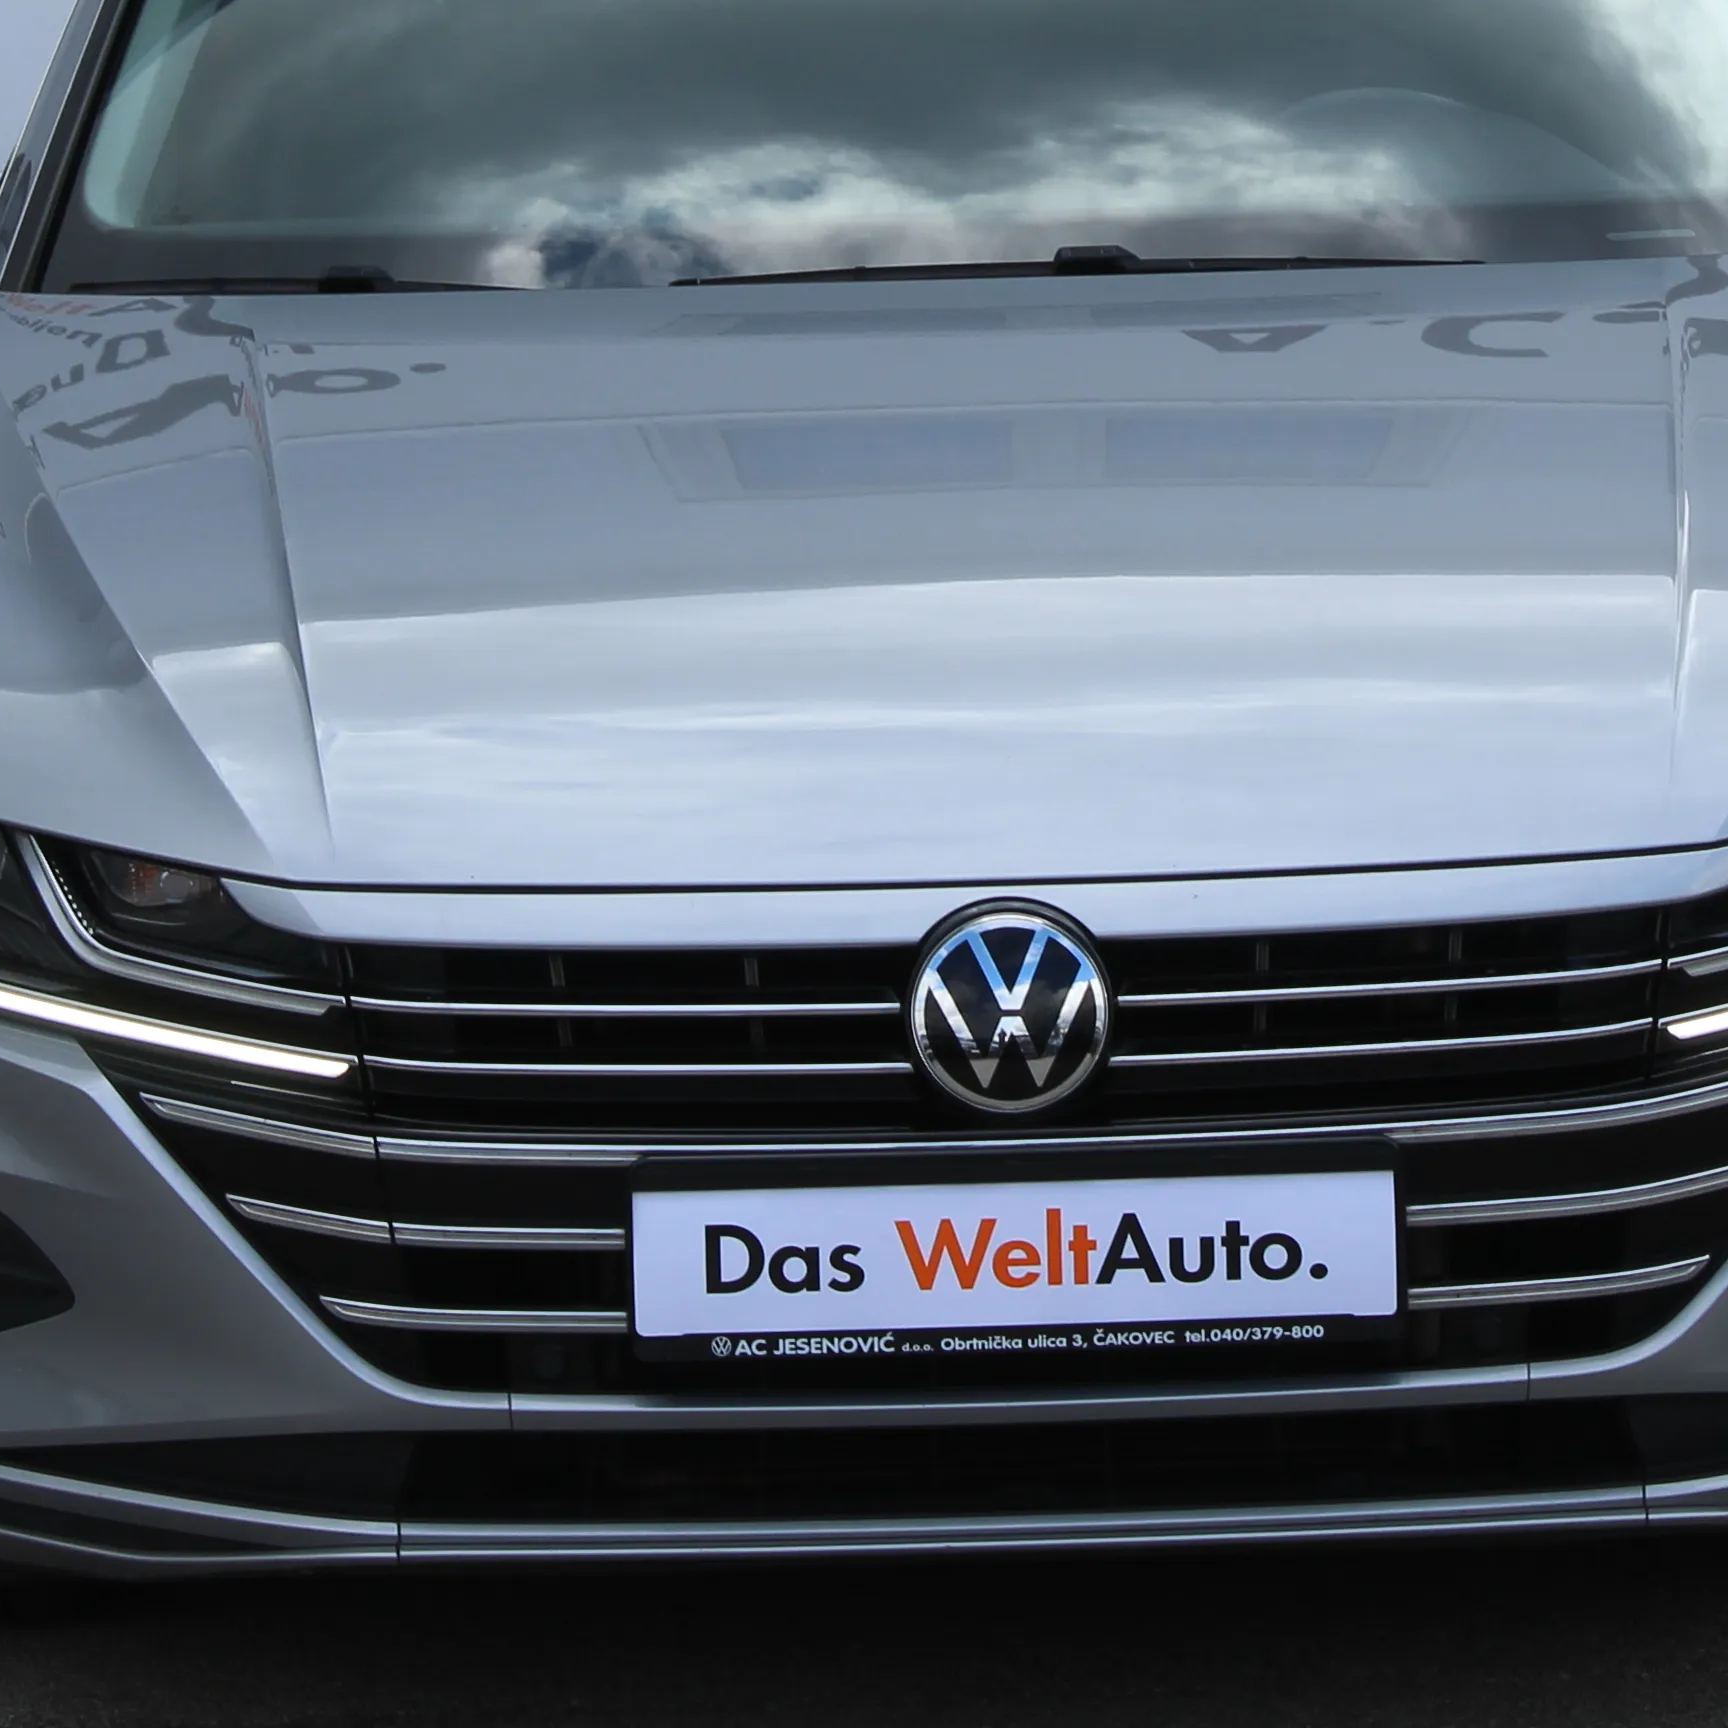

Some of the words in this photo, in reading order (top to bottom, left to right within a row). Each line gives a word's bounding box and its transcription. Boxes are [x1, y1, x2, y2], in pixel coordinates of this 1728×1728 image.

[703, 1222, 866, 1296] Das
[893, 1207, 1330, 1292] WeltAuto.
[734, 1338, 768, 1356] AC
[772, 1332, 896, 1355] JESENOVIĆ
[901, 1341, 935, 1353] d.o.o.
[940, 1334, 1023, 1352] Obrtnička
[1027, 1333, 1067, 1349] ulica
[1072, 1332, 1089, 1350] 3,
[1092, 1328, 1176, 1347] ČAKOVEC
[1183, 1324, 1326, 1344] tel.040/379-800
